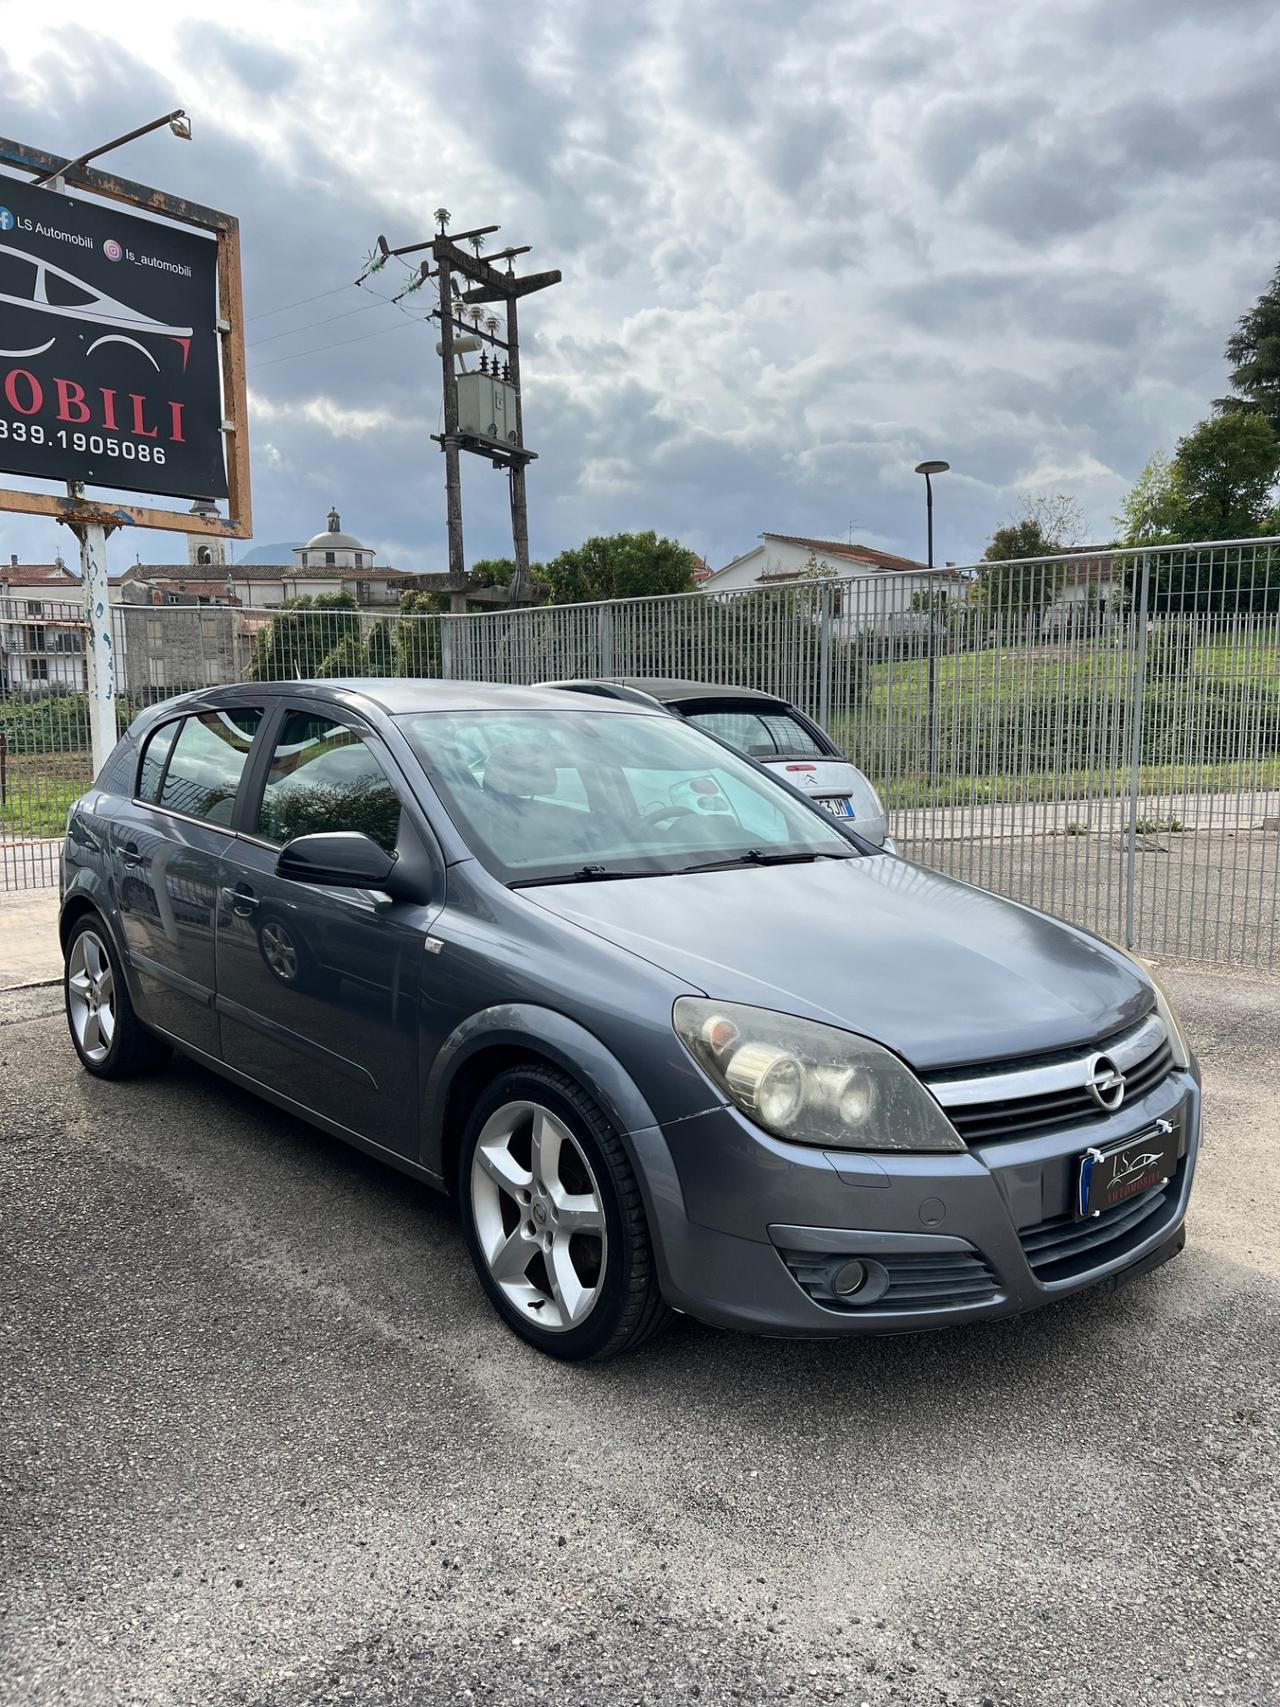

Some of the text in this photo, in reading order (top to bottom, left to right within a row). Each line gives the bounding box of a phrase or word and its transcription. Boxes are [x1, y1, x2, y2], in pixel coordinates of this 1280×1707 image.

[17, 216, 94, 249] LS Automobili
[125, 248, 192, 278] ls_automobili
[4, 368, 186, 442] OBILI
